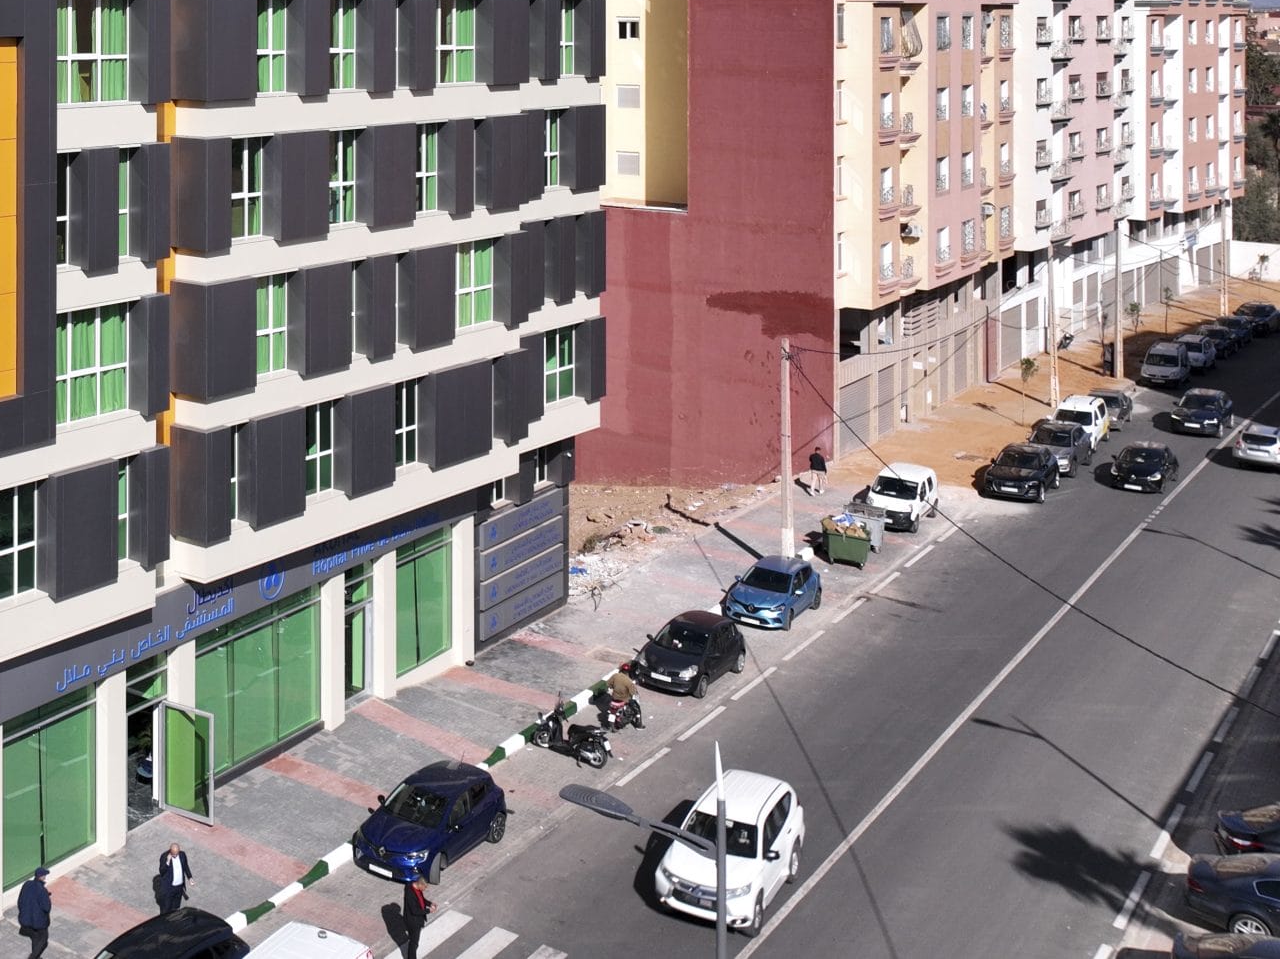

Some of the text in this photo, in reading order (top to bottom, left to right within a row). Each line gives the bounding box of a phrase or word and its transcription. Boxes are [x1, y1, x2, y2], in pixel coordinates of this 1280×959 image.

[56, 597, 235, 692] المستشفى الخاص بني ملال
